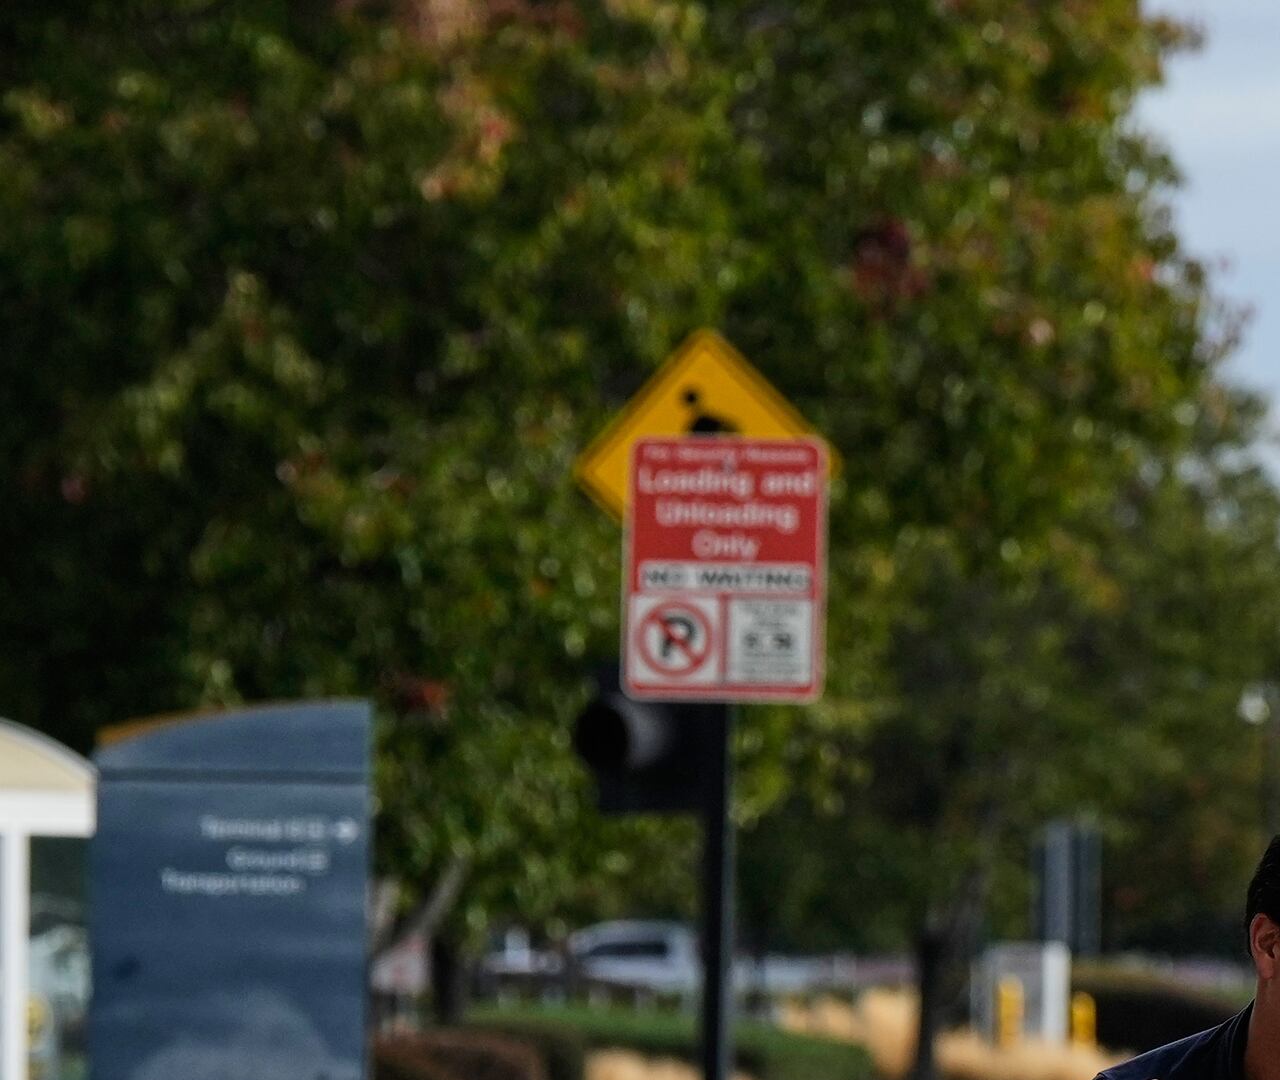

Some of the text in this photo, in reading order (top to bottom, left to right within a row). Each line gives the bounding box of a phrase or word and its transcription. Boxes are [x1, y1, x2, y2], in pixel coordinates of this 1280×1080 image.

[638, 465, 817, 498] Loading and
[656, 498, 799, 534] Unloading
[691, 529, 759, 561] Only
[700, 569, 809, 588] WAITING
